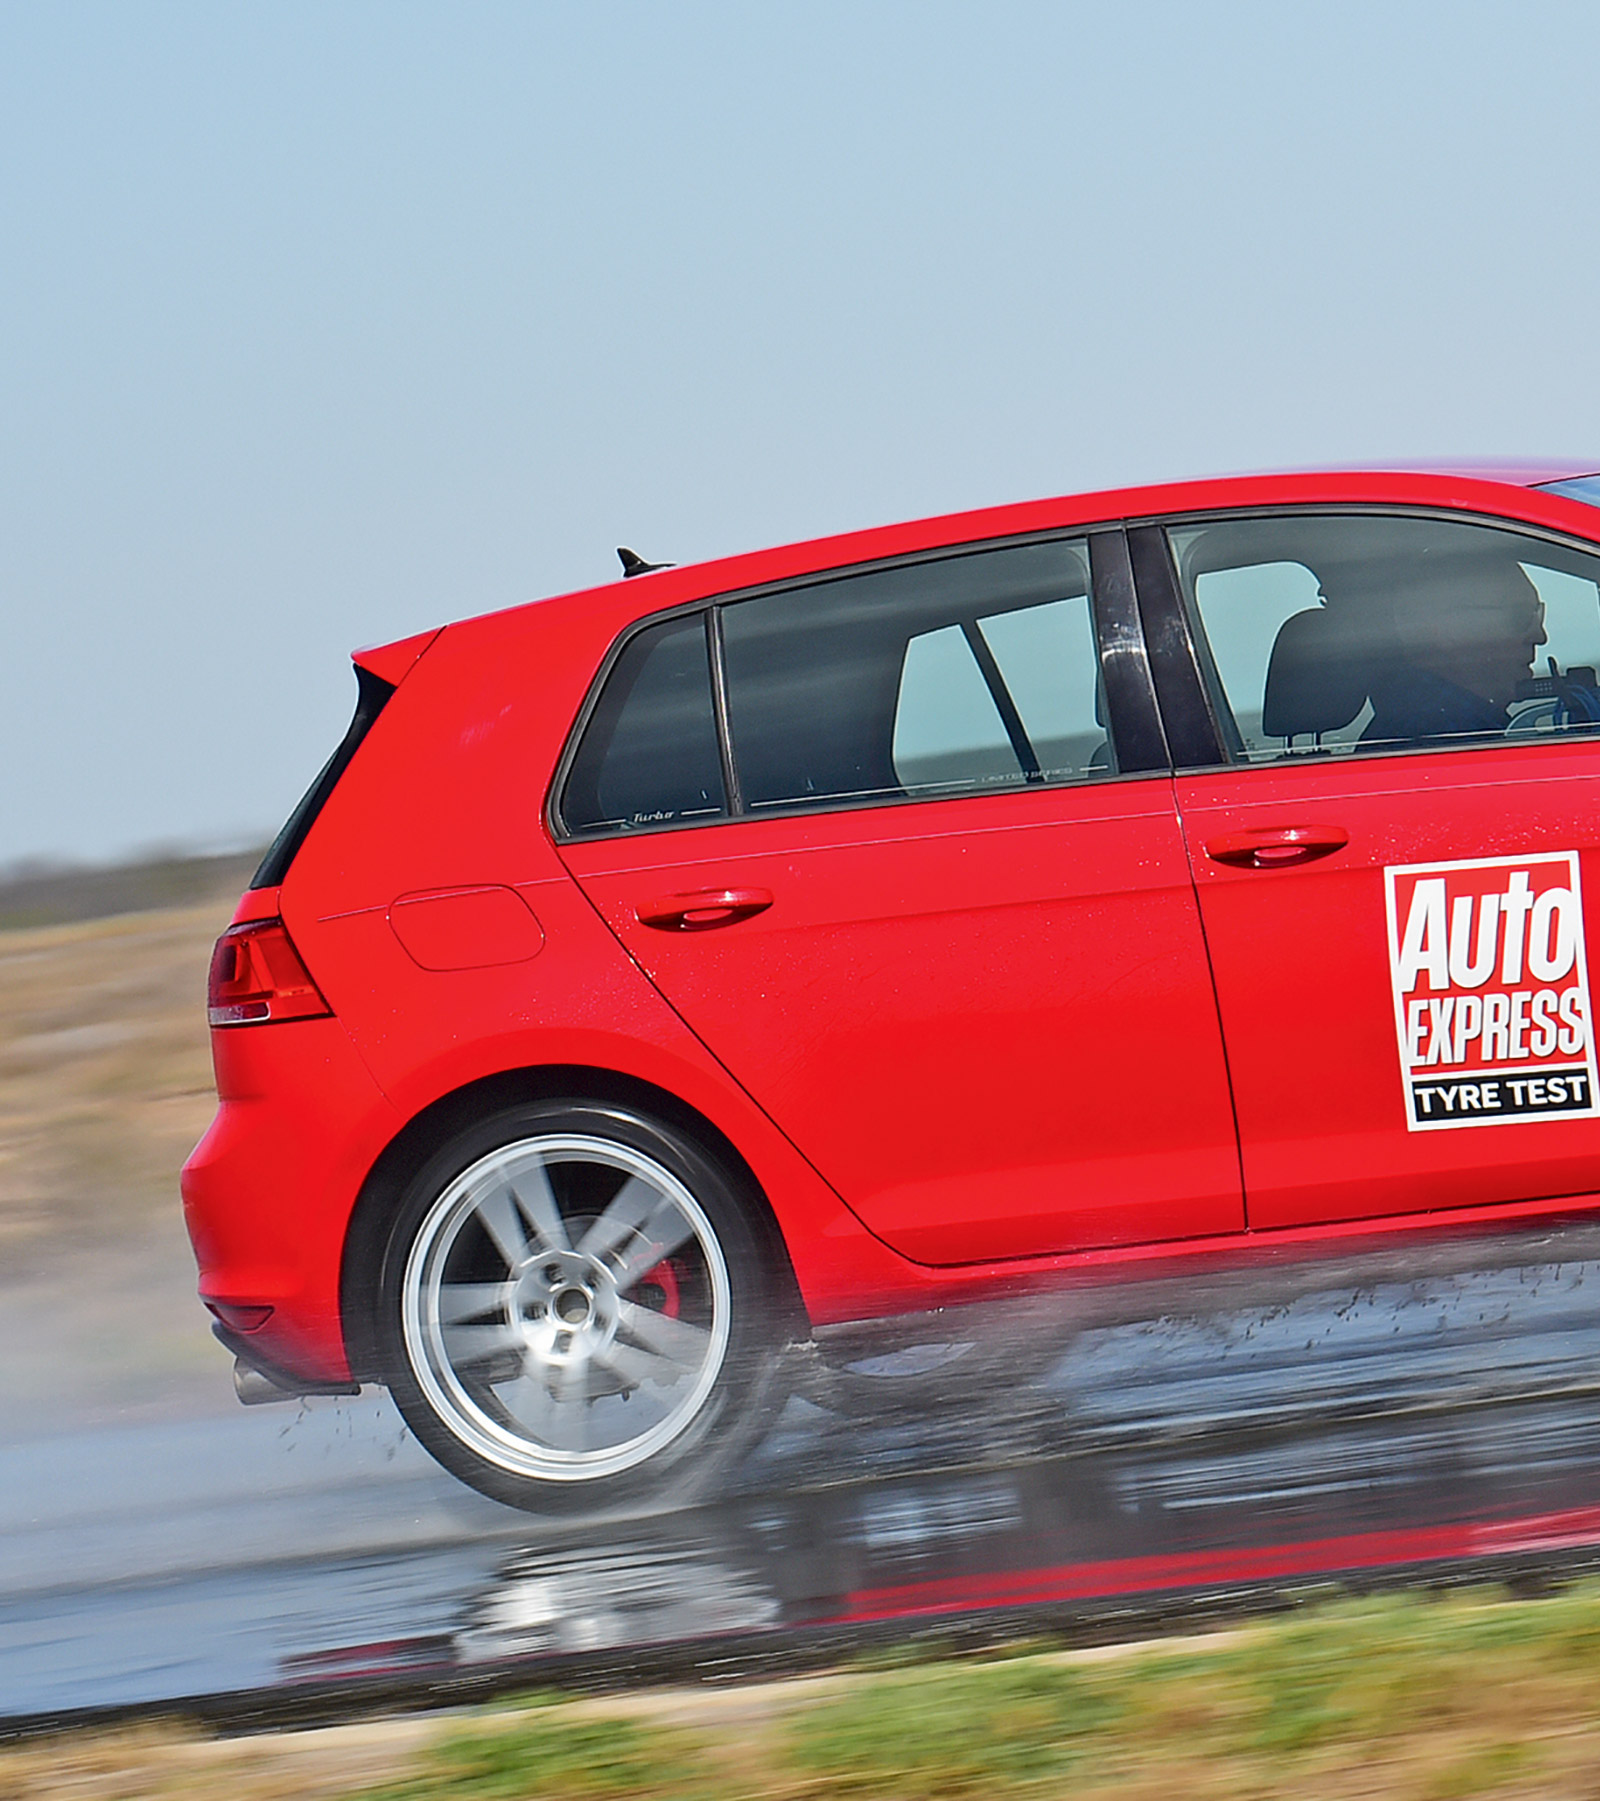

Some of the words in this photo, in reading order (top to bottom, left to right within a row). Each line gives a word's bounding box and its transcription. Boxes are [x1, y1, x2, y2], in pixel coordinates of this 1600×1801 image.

[633, 811, 675, 822] Turbo
[1399, 870, 1577, 993] Auto
[1405, 986, 1586, 1067] EXPRESS
[1414, 1082, 1502, 1114] TYRE
[1505, 1075, 1588, 1107] TEST
